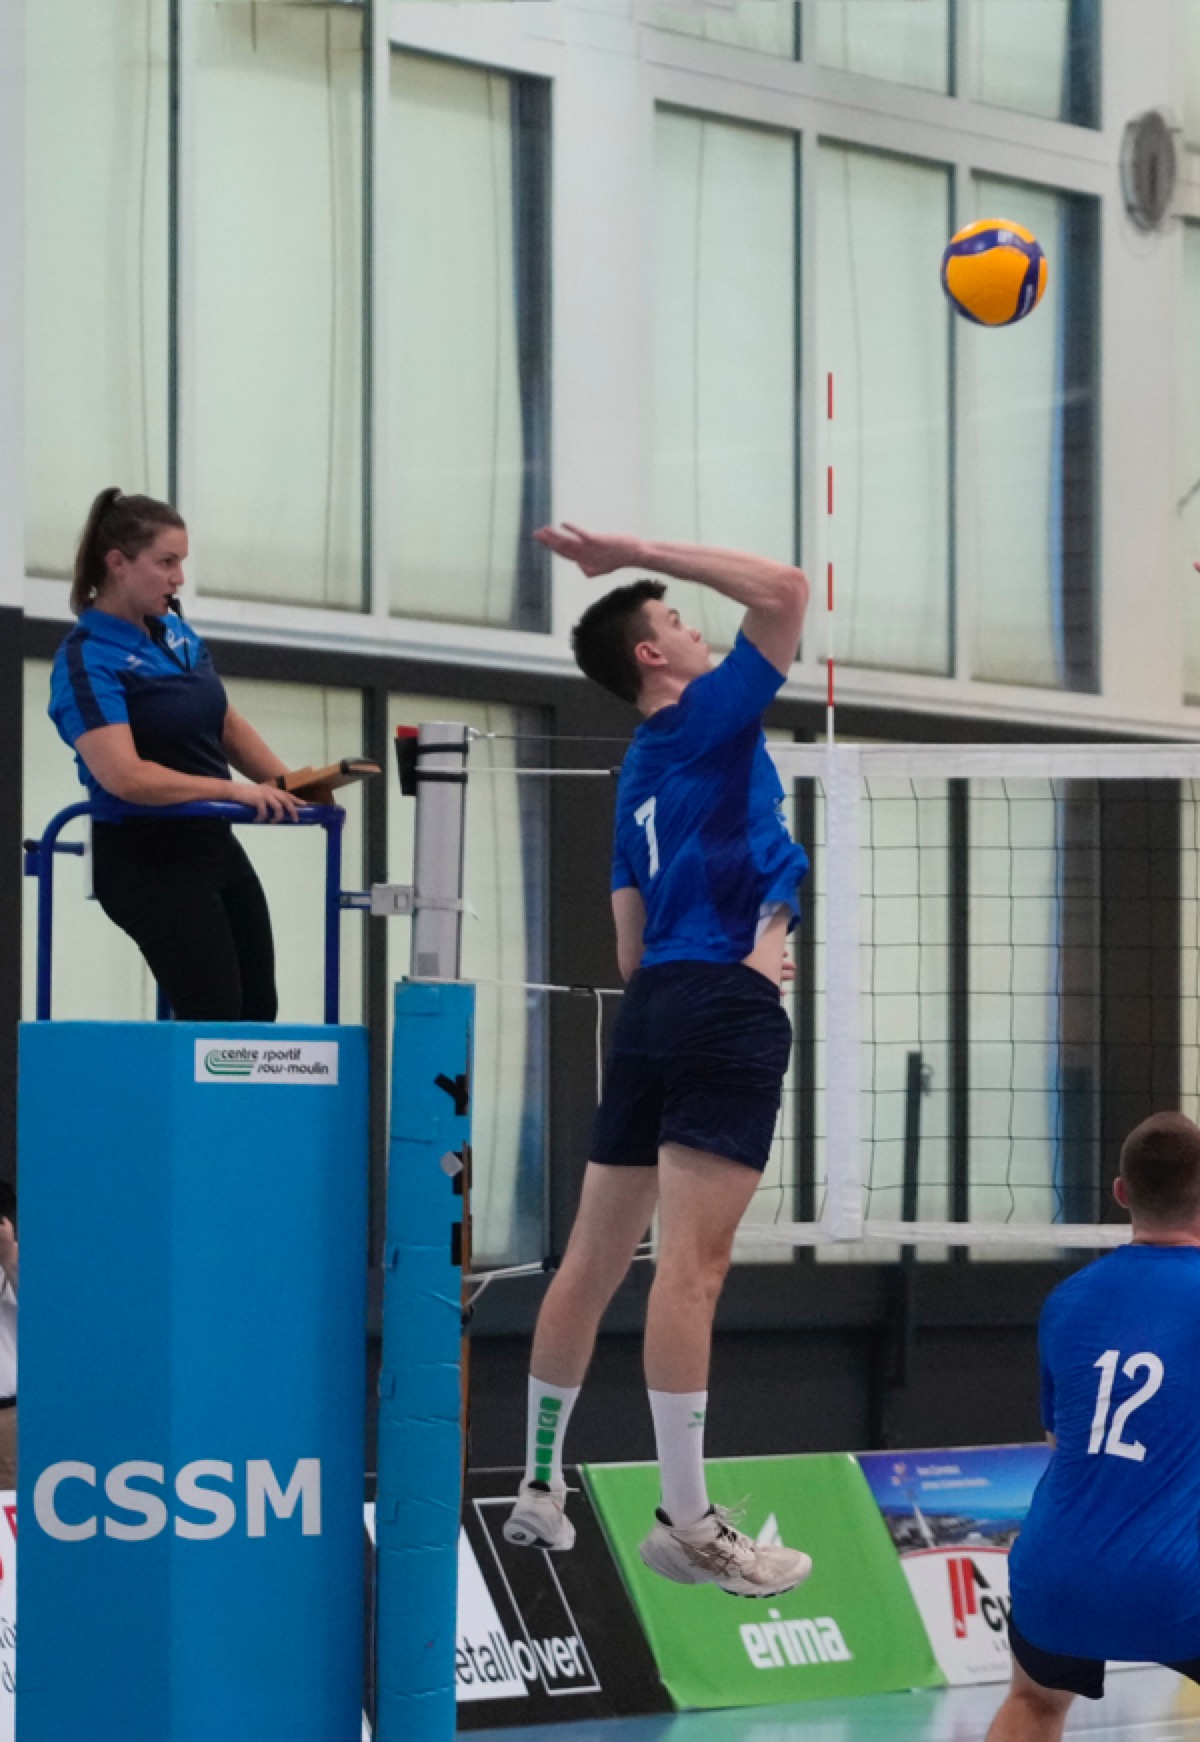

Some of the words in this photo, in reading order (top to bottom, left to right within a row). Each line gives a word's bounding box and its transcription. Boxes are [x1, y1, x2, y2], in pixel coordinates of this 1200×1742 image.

[221, 1048, 258, 1060] centre
[1087, 1349, 1165, 1462] 12
[33, 1457, 322, 1542] CSSM
[739, 1607, 854, 1669] erima
